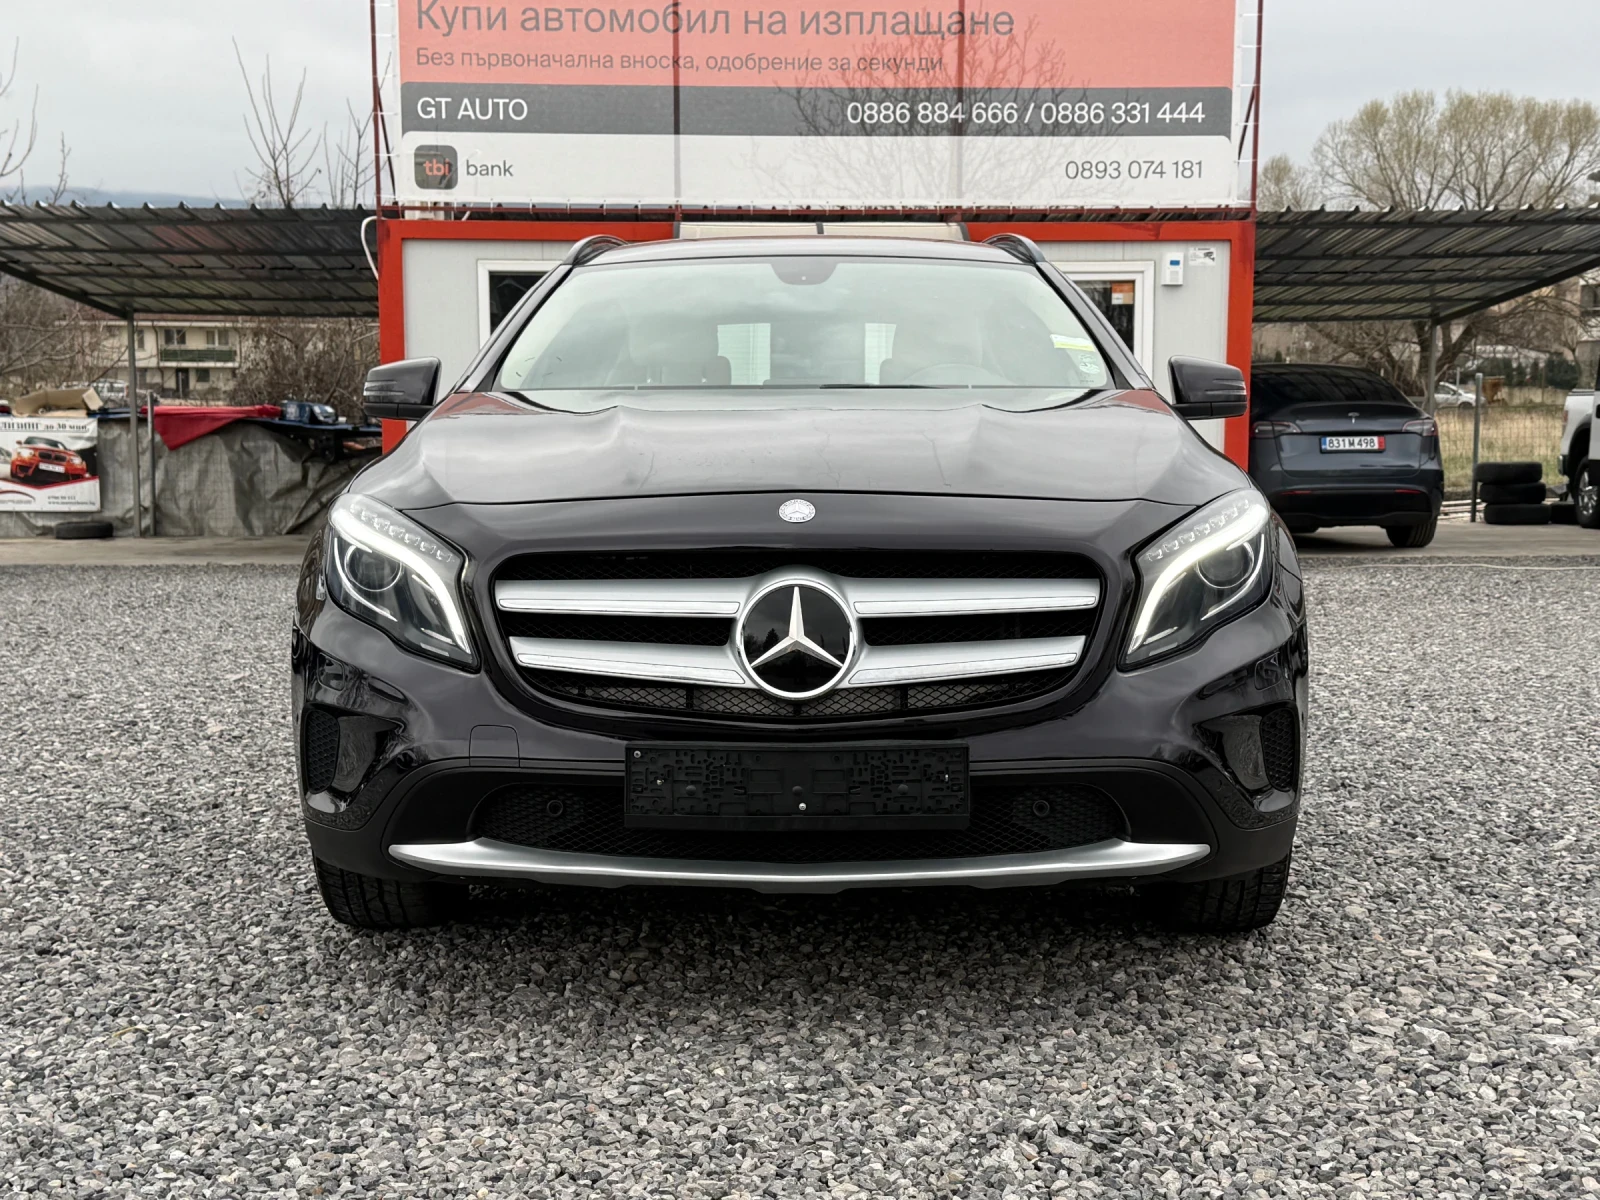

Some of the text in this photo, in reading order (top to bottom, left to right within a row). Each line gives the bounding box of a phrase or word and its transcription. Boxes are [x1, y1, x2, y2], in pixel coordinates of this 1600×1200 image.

[417, 0, 1014, 39] Купи автомобил на изплащане
[416, 47, 943, 75] Без първоначална вноска, одобрение за секунди
[417, 97, 528, 120] GT AUTO
[847, 101, 911, 124] 0886
[917, 102, 966, 124] 884
[971, 102, 1018, 124] 666
[1040, 102, 1105, 124] 0886
[1110, 102, 1150, 124] 331
[1156, 102, 1206, 124] 444
[423, 159, 450, 176] tbi
[465, 160, 514, 178] bank
[1065, 160, 1203, 179] 0893 074 181
